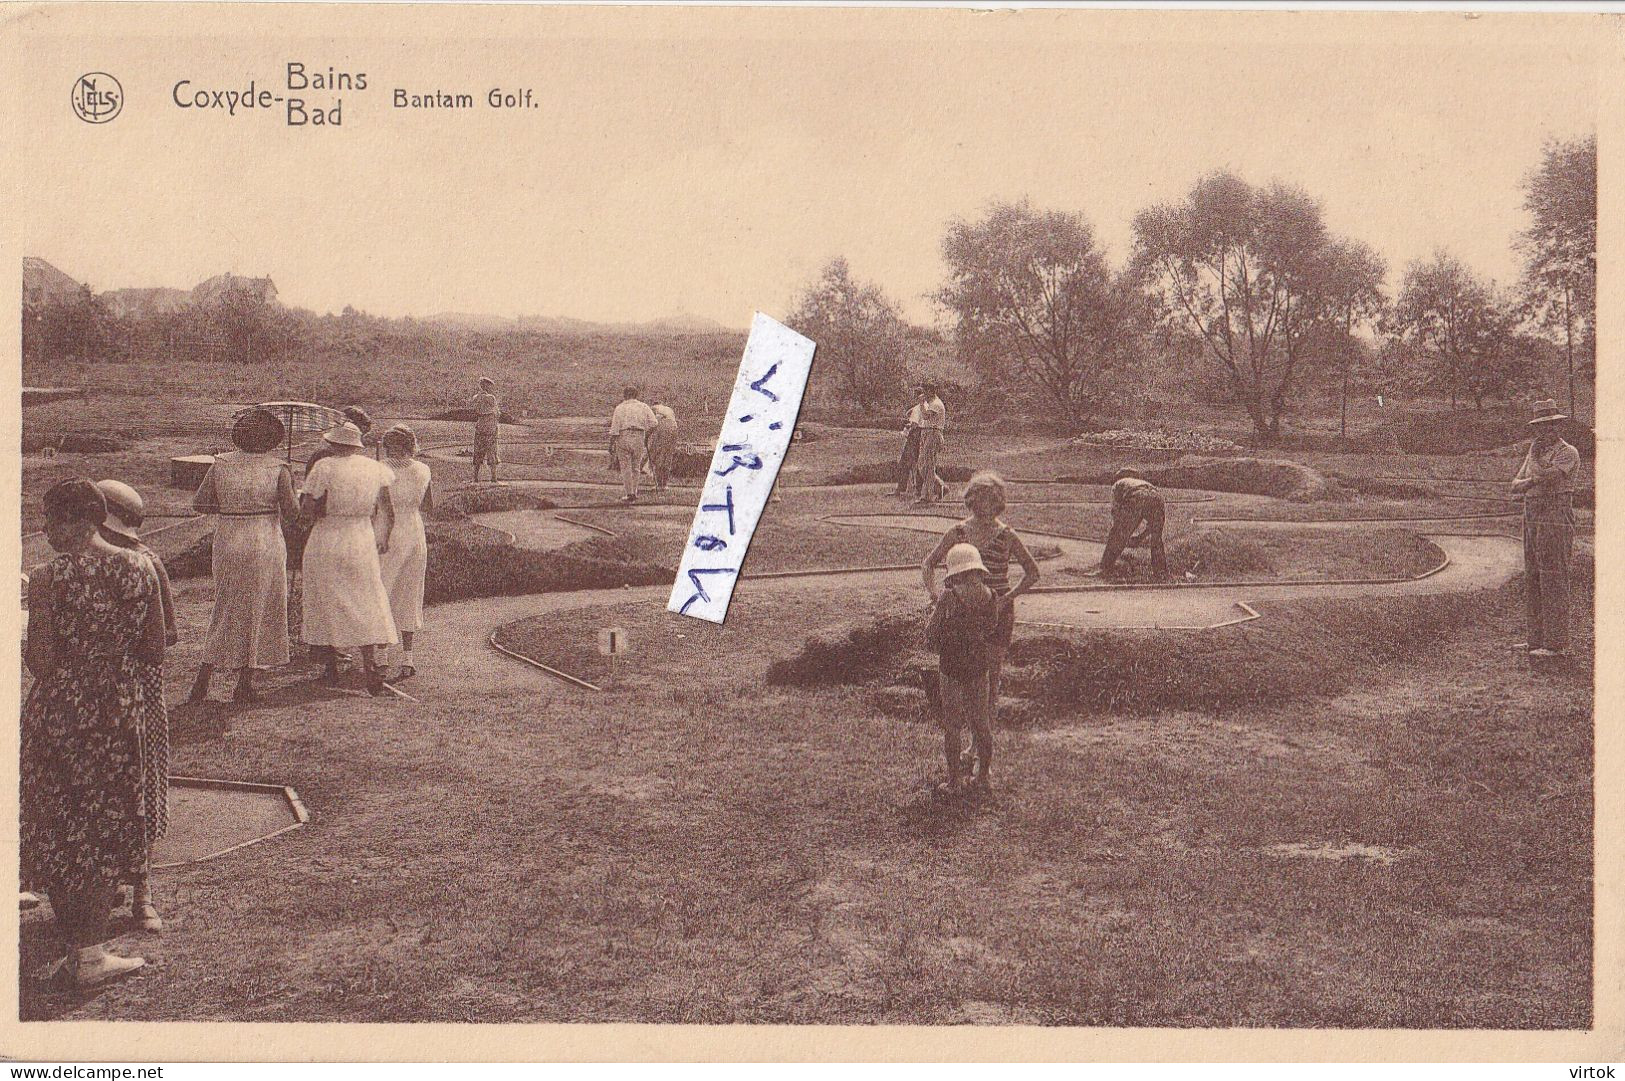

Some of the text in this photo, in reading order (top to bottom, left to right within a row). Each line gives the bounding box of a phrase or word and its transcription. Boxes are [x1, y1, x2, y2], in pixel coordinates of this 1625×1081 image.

[172, 62, 368, 117] Coxyde- Bains
[393, 87, 539, 109] Bantam Golf.
[287, 98, 342, 126] Bad
